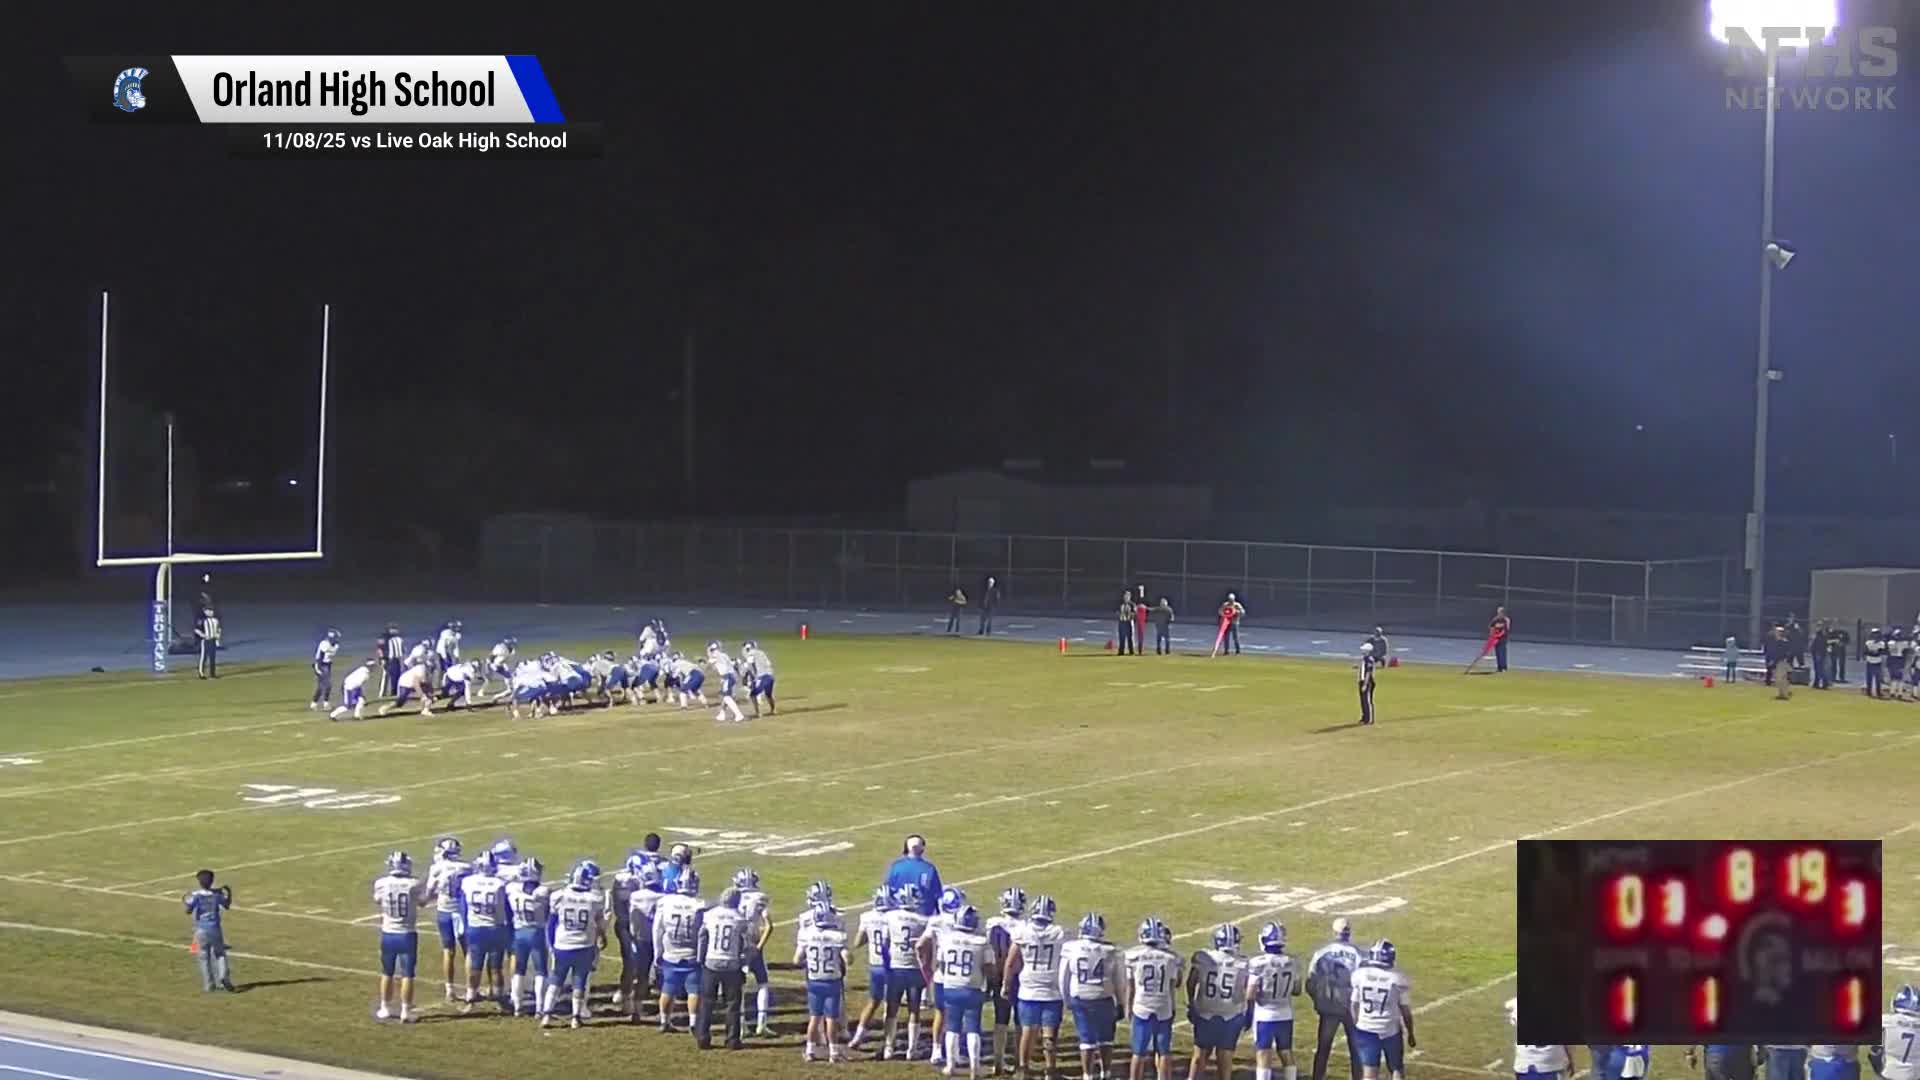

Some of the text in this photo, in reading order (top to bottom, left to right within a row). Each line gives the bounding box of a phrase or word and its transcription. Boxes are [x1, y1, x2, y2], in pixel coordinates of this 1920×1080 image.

[671, 914, 691, 940] 71
[714, 924, 732, 951] 18
[809, 946, 834, 973] 32
[947, 949, 973, 976] 28
[1028, 944, 1054, 971] 77
[1077, 957, 1104, 985] 64
[1143, 964, 1165, 993] 21
[1207, 971, 1234, 999] 65
[1272, 971, 1293, 999] 17
[1362, 986, 1389, 1015] 57
[1901, 1032, 1915, 1063] 7
